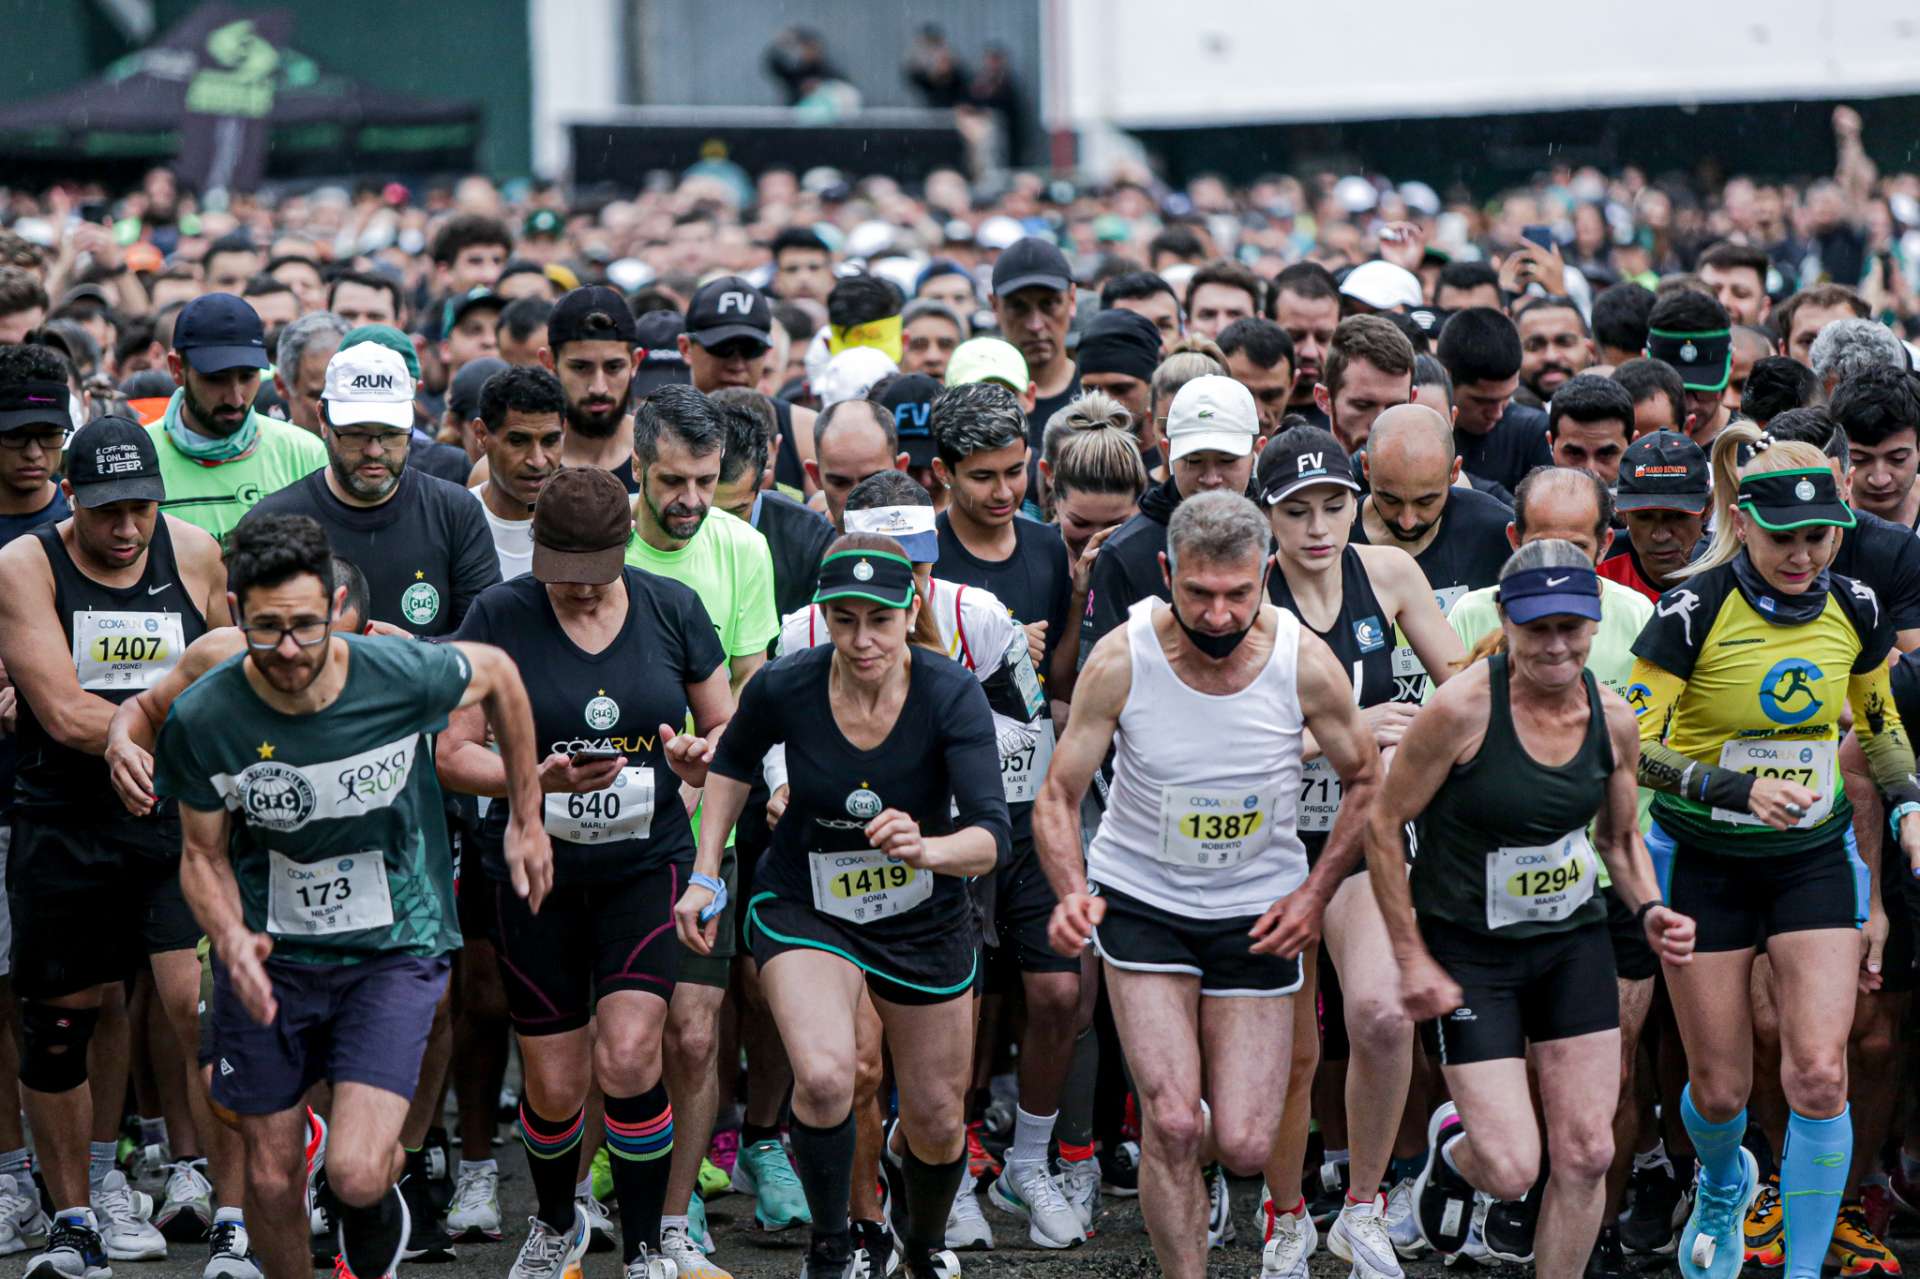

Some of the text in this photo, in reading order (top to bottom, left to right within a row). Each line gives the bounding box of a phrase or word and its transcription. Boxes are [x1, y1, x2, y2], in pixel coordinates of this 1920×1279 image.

[717, 291, 754, 315] FV
[351, 374, 393, 389] 4RUN
[895, 402, 930, 427] FV
[106, 460, 143, 473] JEEP.
[1296, 451, 1323, 473] FV
[98, 636, 162, 662] 1407
[111, 663, 143, 671] ROSINEI
[1007, 774, 1028, 783] KAIKE
[252, 792, 297, 810] CFC
[567, 792, 621, 820] 640
[580, 821, 607, 830] MARLI
[1188, 811, 1259, 840] 1387
[1201, 840, 1243, 850] ROBERTO
[838, 865, 908, 898] 1419
[1515, 858, 1580, 897] 1294
[296, 877, 352, 908] 173
[862, 892, 889, 905] SONIA
[1534, 893, 1568, 905] MARCIA
[311, 903, 344, 918] NILSON
